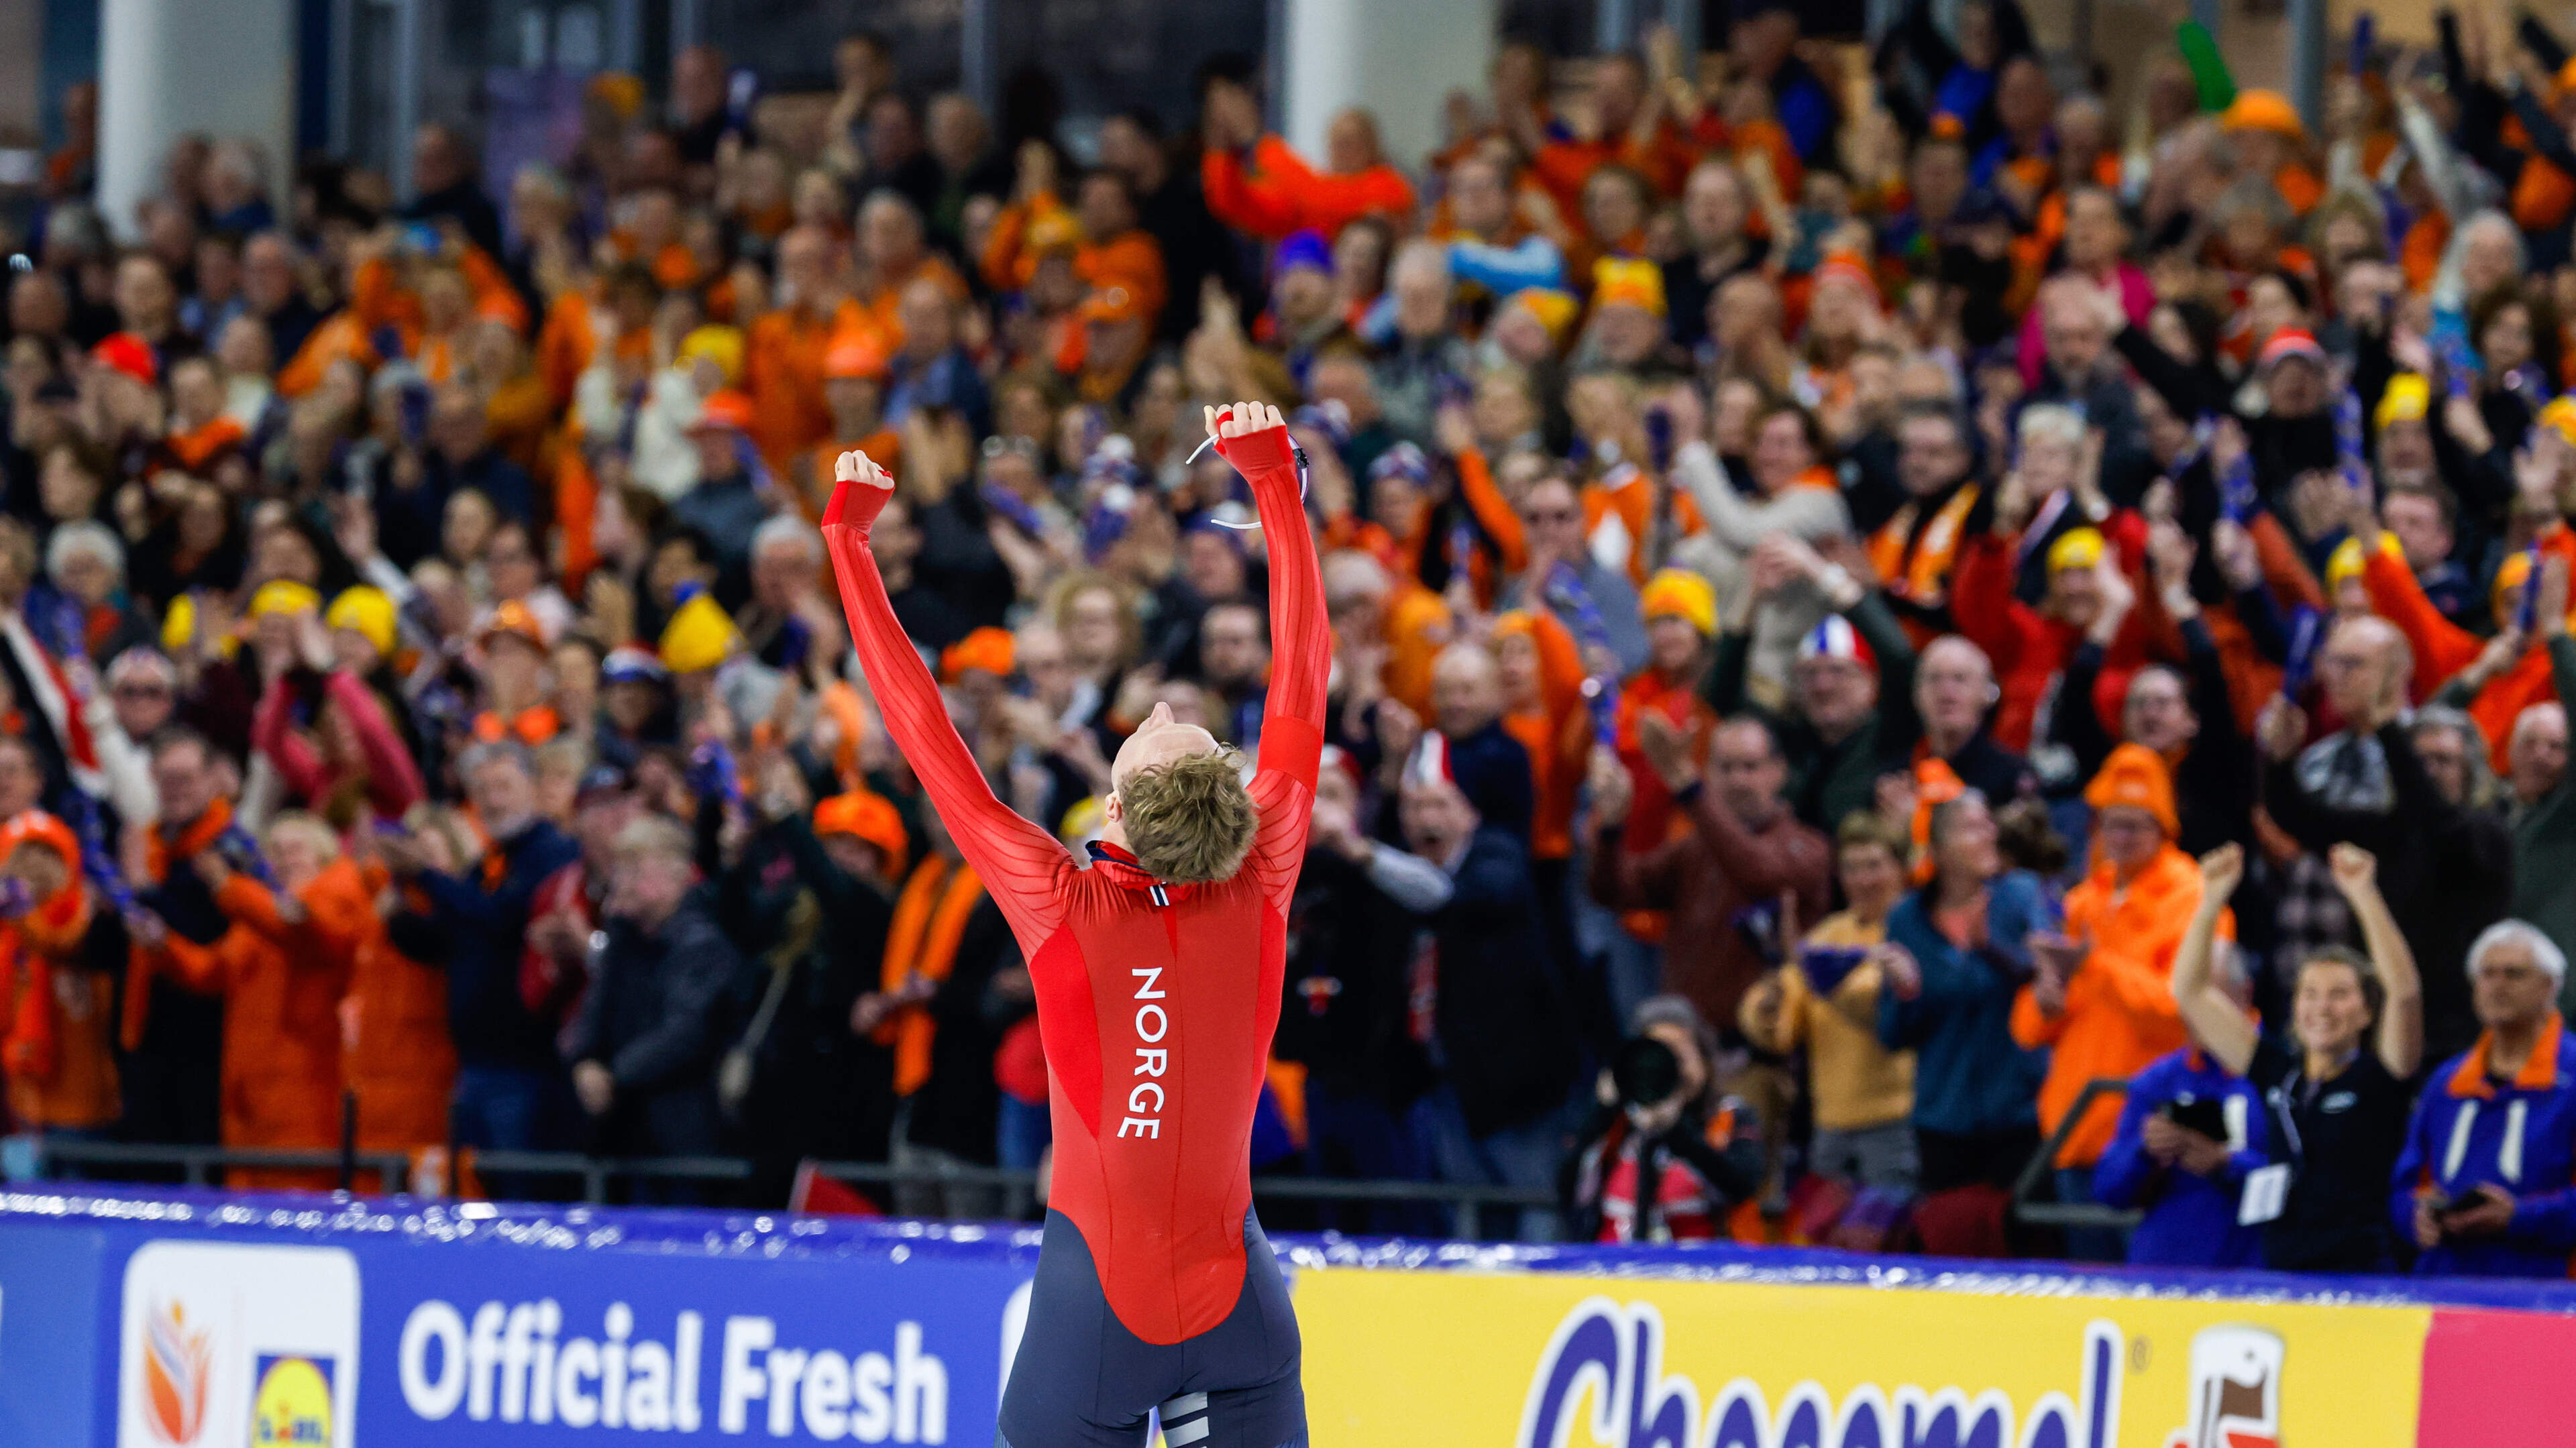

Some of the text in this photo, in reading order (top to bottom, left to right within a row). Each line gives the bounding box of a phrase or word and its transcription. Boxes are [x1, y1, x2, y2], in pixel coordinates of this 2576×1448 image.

[1116, 966, 1168, 1139] NORGE
[400, 1298, 948, 1445] Official Fresh
